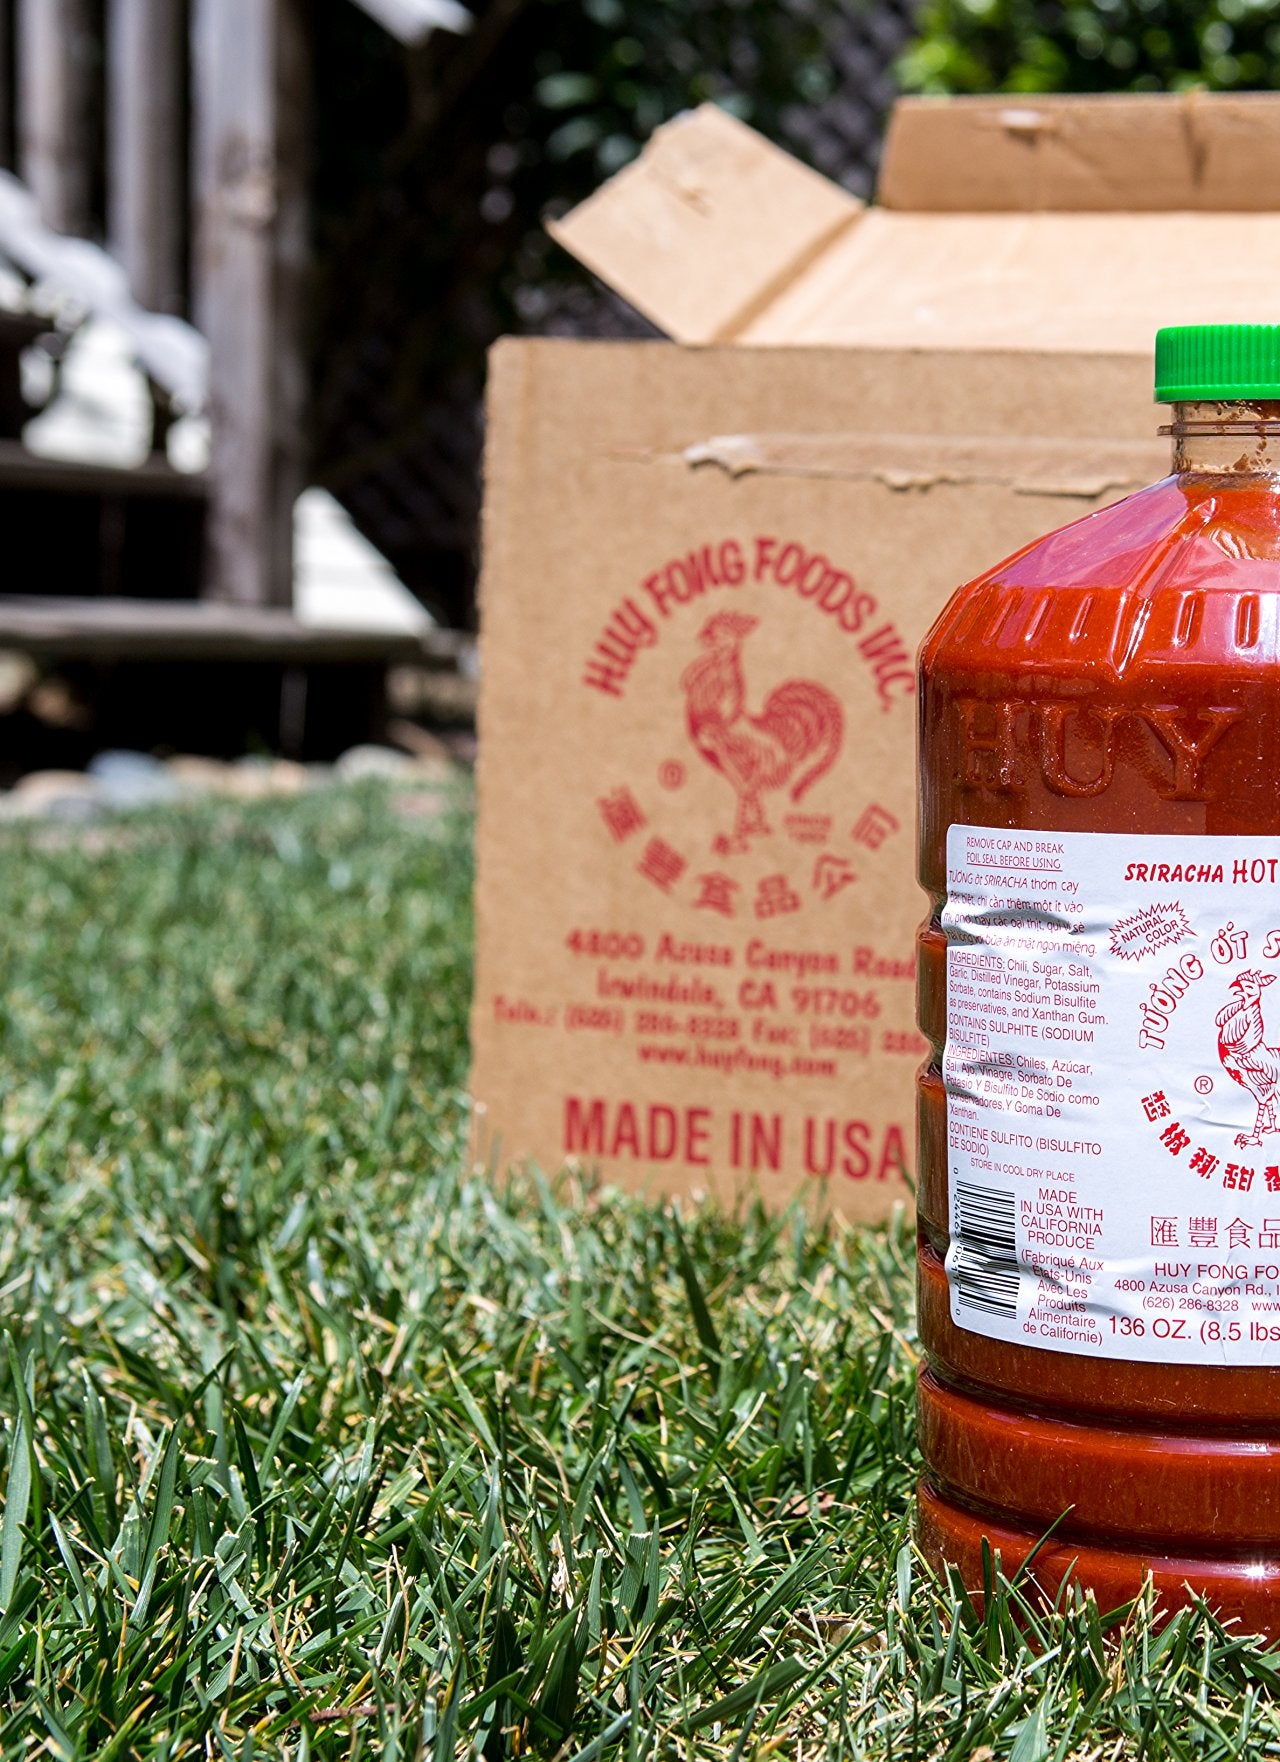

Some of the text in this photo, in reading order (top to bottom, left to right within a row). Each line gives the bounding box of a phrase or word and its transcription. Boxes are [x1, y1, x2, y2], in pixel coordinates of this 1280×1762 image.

[583, 535, 916, 714] HUY FONG FOODS INC.
[959, 702, 1246, 801] HUY
[967, 837, 1064, 853] REMOVE CAP AND BREAK
[967, 852, 1060, 869] FOIL SEAL BEFORE USING
[1125, 863, 1223, 883] SRIRACHA
[1233, 859, 1278, 883] HOT
[1121, 915, 1166, 943] NATURAL
[1145, 920, 1179, 942] COLOR
[565, 929, 916, 982] 4800 Azusa Canyon Road
[597, 966, 880, 1019] Irwindale, CA 91706
[971, 970, 1000, 984] Distilled
[1045, 978, 1100, 993] Potassium
[978, 987, 1011, 1001] contains
[1015, 990, 1050, 1004] Sodium
[1054, 995, 1096, 1008] Bisulfite
[950, 998, 956, 1006] as
[1012, 1006, 1029, 1018] and
[1032, 1008, 1074, 1022] Xanthan
[950, 1013, 1094, 1042] CONTAINS SULPHITE (SODIUM
[950, 1028, 990, 1048] BISULFITE)
[638, 1044, 837, 1078] www.huyfong.com
[565, 1096, 913, 1181] MADE IN USA
[1039, 1188, 1077, 1203] MADE
[1021, 1200, 1103, 1221] IN USA WITH
[1022, 1215, 1102, 1235] CALIFORNIA
[1028, 1231, 1095, 1250] PRODUCE
[1022, 1249, 1104, 1271] (Fabriqué Aux
[1154, 1263, 1191, 1278] HUY
[1198, 1264, 1248, 1279] FONG
[1038, 1280, 1087, 1298] Avec Les
[1114, 1280, 1145, 1291] 4800
[1150, 1282, 1188, 1294] Azusa
[1192, 1283, 1240, 1298] Canyon
[1246, 1284, 1271, 1297] Rd.,
[1038, 1295, 1086, 1312] Produits
[1142, 1296, 1175, 1310] (626)
[1179, 1298, 1239, 1311] 286-8328
[1029, 1308, 1096, 1328] Alimentaire
[1023, 1322, 1102, 1346] de Californie)
[1109, 1316, 1145, 1336] 136
[1153, 1319, 1191, 1339] OZ.
[1200, 1320, 1241, 1344] (8.5
